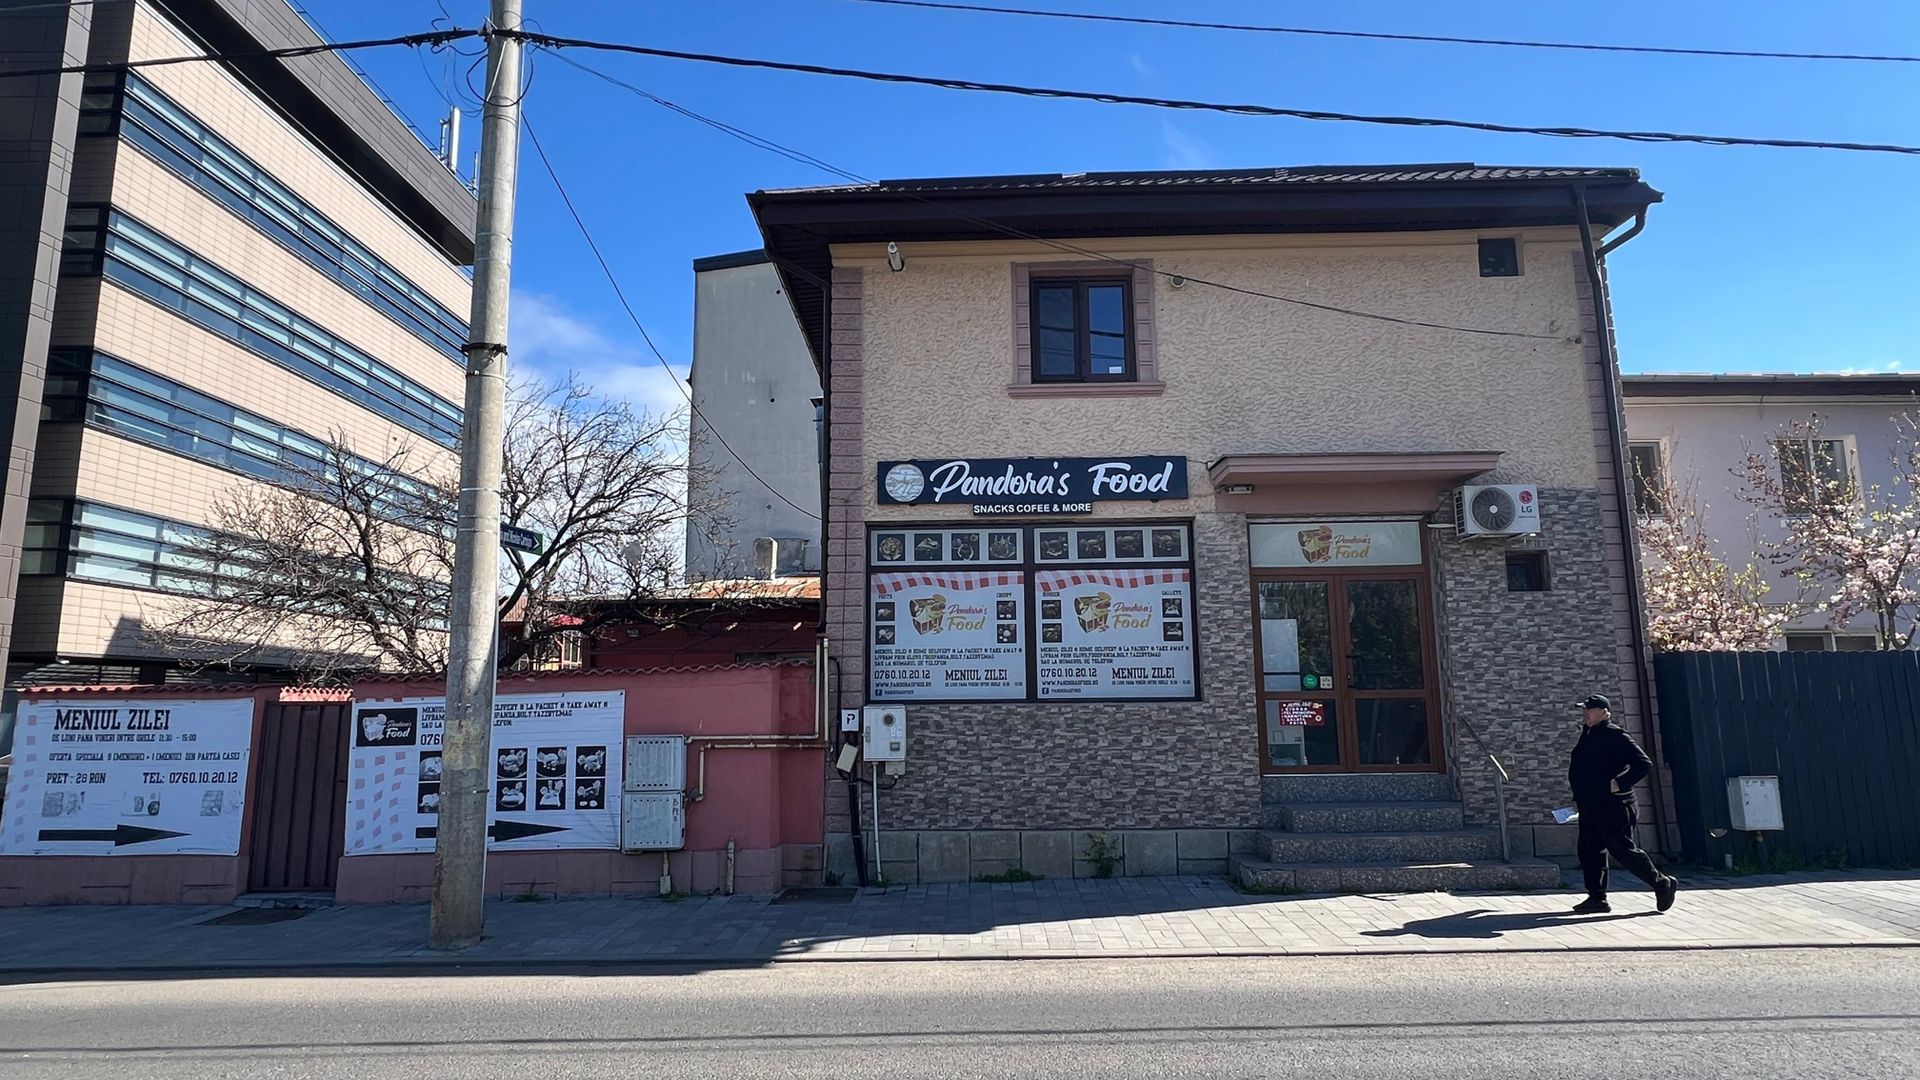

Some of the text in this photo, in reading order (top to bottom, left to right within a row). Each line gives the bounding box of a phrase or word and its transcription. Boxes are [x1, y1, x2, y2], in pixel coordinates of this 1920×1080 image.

[929, 460, 1174, 502] Pandora's Food
[973, 503, 1092, 514] SNACKS COFEE & MORE
[1521, 505, 1533, 513] LG
[1335, 545, 1370, 560] Food
[947, 604, 988, 615] Pandora's
[1113, 602, 1153, 613] Pandora's
[946, 615, 986, 631] Food
[1112, 613, 1151, 630] Food
[874, 669, 931, 679] 0760.10.20.12
[945, 669, 1008, 681] MENIUL ZILEI
[1041, 668, 1098, 677] 0760.10.20.12
[1112, 667, 1175, 679] MENIUL ZILEI
[584, 701, 602, 709] AWAY
[54, 709, 170, 730] MENIUL ZILEI
[77, 733, 93, 742] PANA
[116, 733, 135, 742] INTRE
[385, 727, 411, 739] Food
[49, 753, 72, 761] OFERTA
[75, 753, 104, 761] SPECIALA
[222, 752, 240, 760] CASEI
[46, 772, 69, 784] PRET
[89, 772, 106, 784] RON
[143, 771, 238, 784] TEL: 0760.10.20.12
